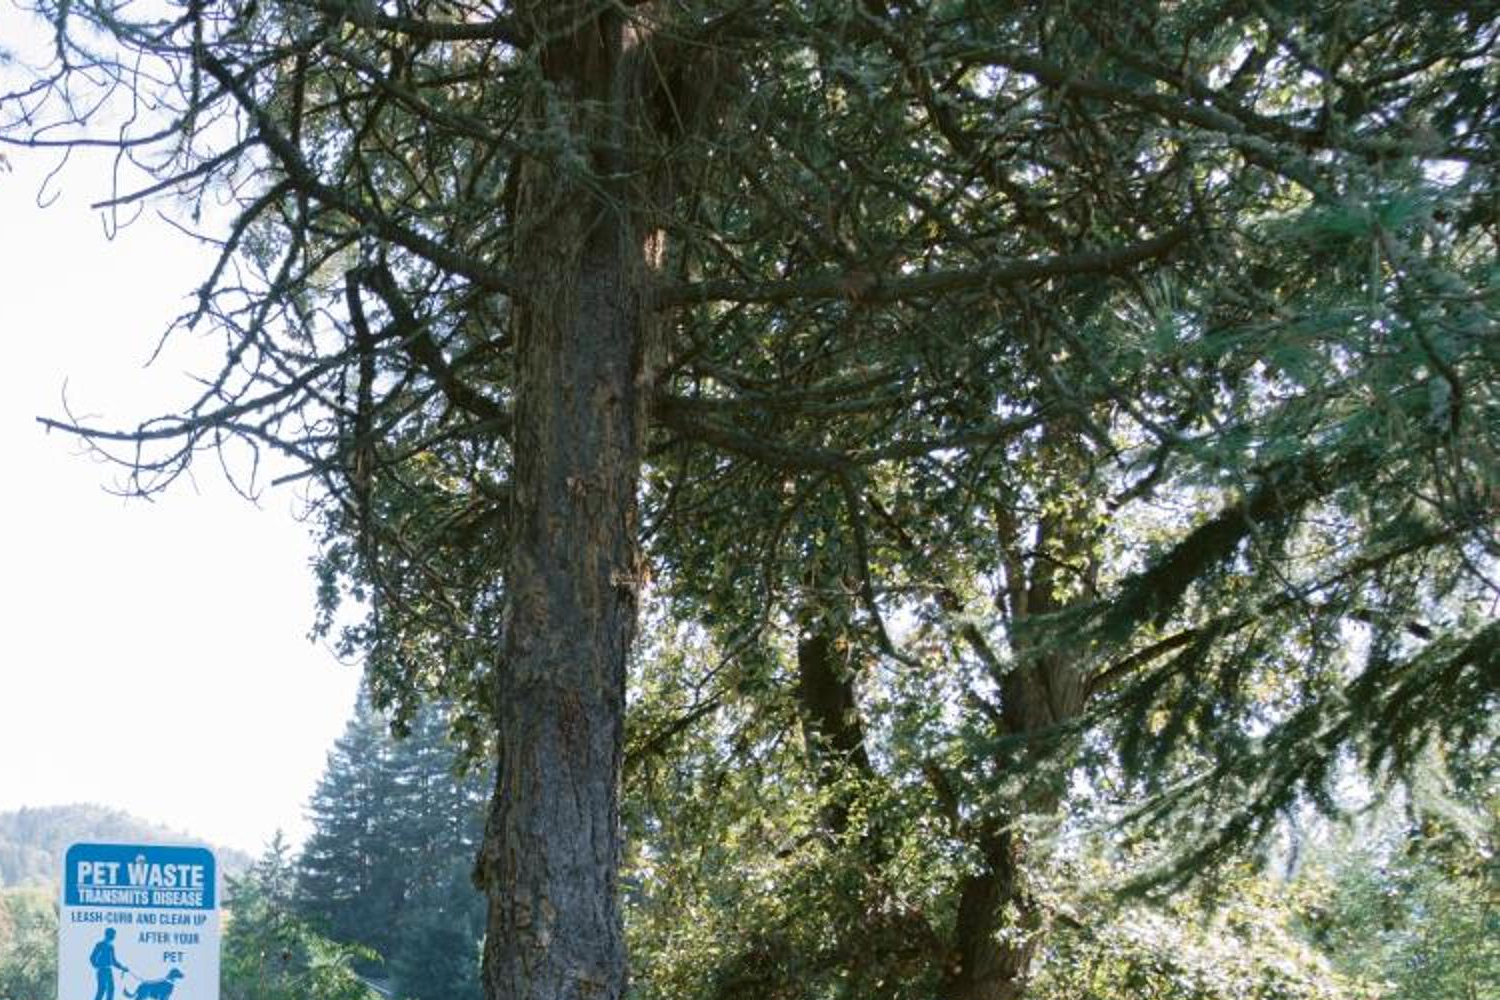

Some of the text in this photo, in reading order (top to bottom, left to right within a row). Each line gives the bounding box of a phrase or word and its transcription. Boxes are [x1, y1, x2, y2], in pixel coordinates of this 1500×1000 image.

[77, 861, 204, 888] PET WASTE
[78, 889, 203, 906] TRANSMITS DISEASE
[136, 914, 156, 925] AND
[159, 914, 191, 925] CLEAN
[193, 915, 207, 925] UP
[138, 932, 199, 945] AFTER YOUR
[163, 951, 184, 963] PET
